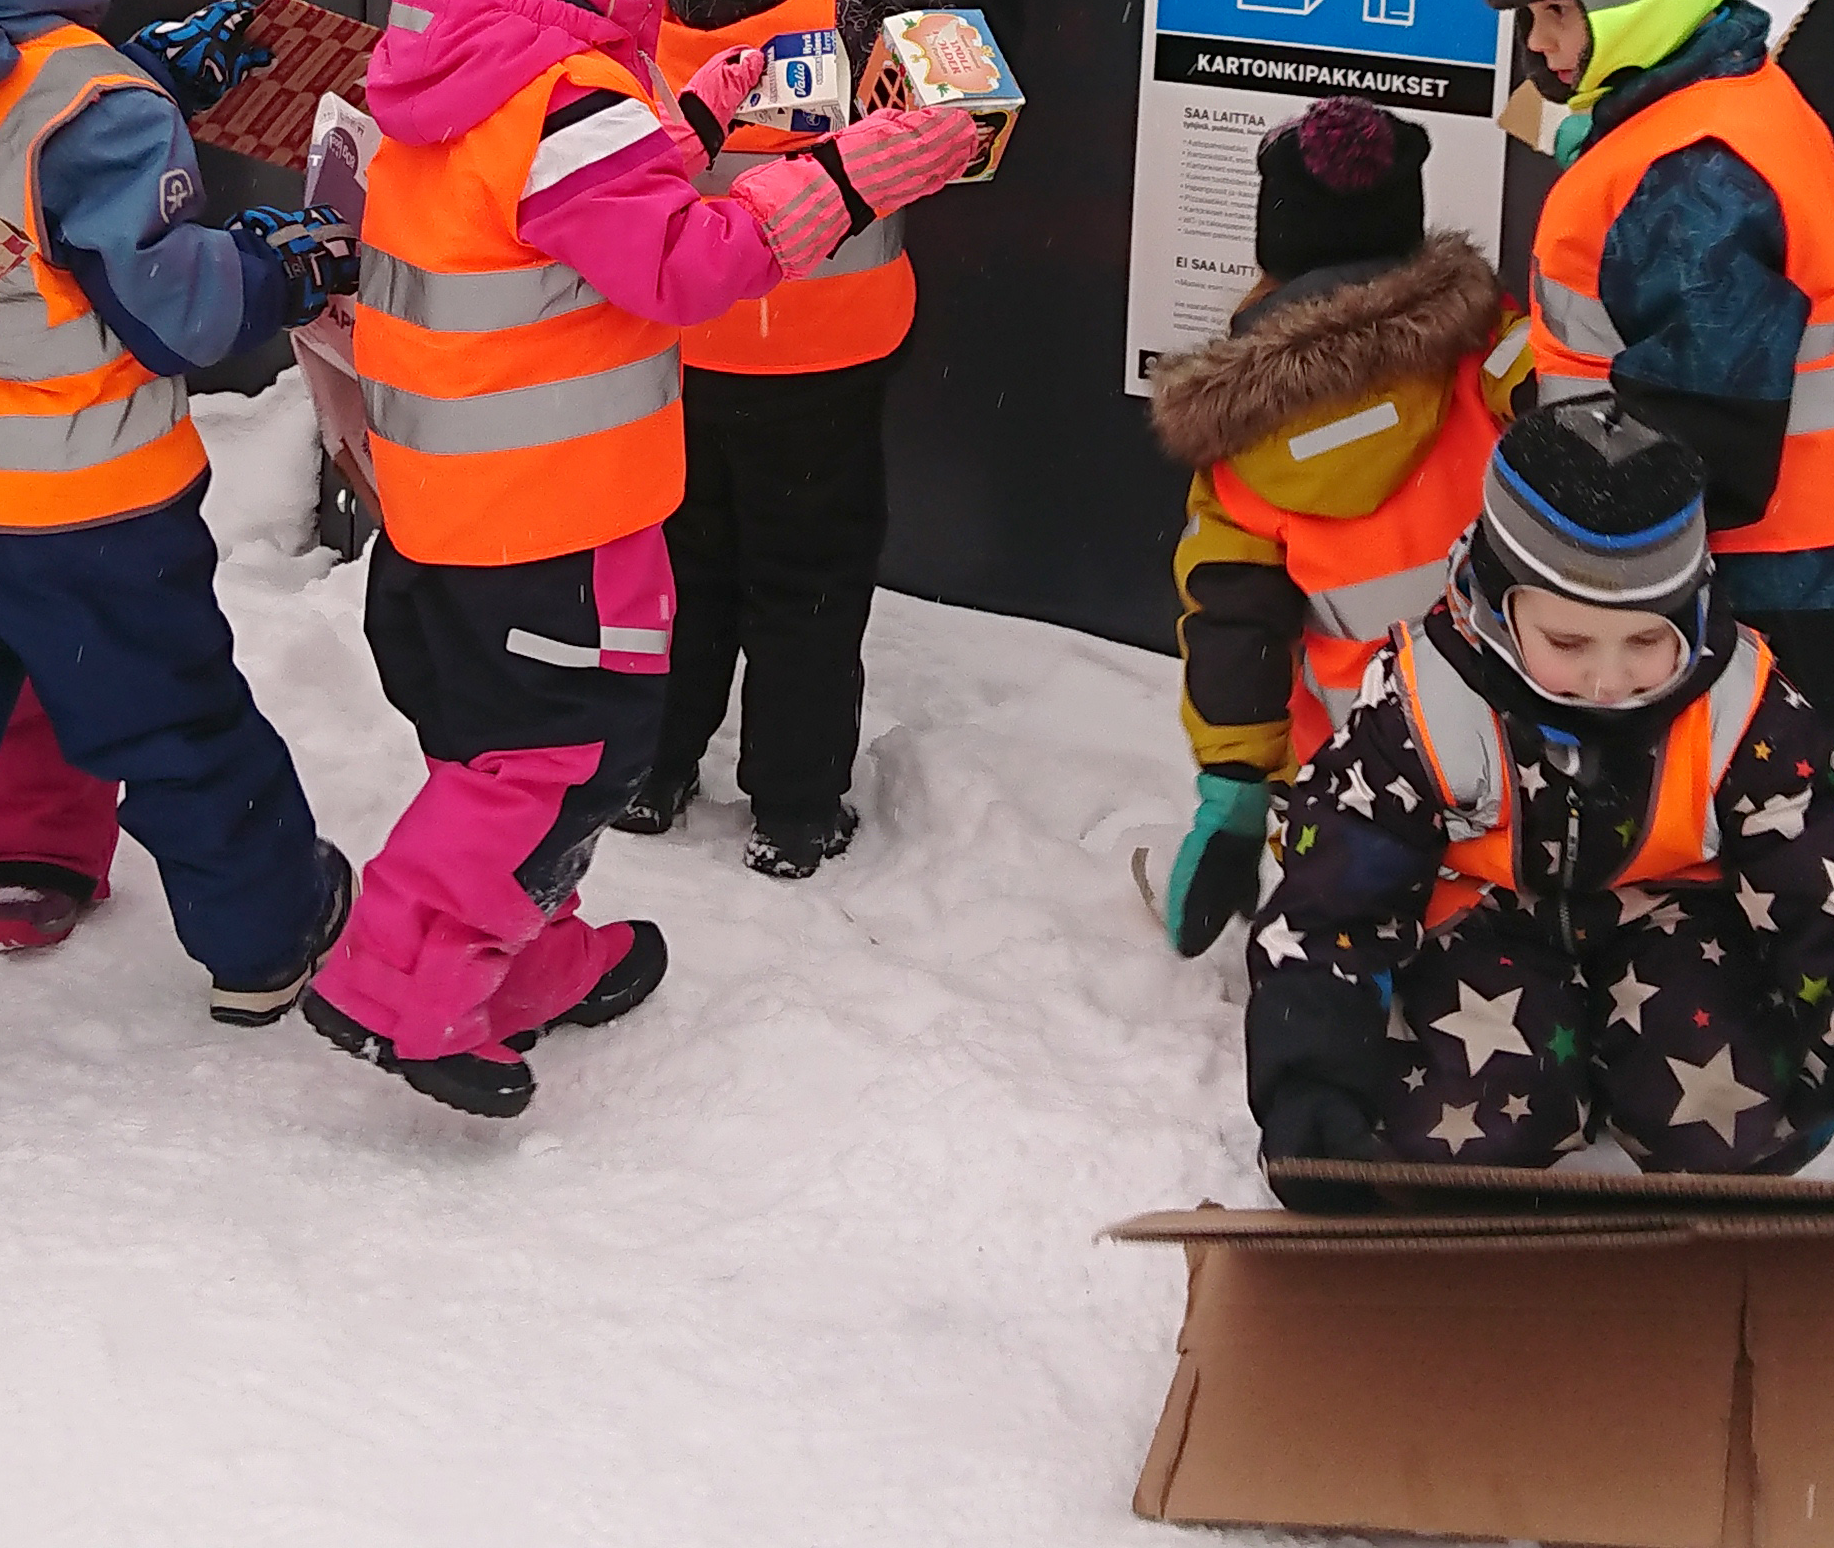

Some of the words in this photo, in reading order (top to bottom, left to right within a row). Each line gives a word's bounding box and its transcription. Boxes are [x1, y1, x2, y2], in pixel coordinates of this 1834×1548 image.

[793, 63, 806, 96] Valio
[1196, 53, 1450, 98] KARTONKIPAKKAUKSET
[1184, 107, 1209, 120] SAA
[1213, 110, 1266, 127] LAITTAA
[1176, 256, 1188, 268] EI
[1191, 258, 1217, 272] SAA
[1220, 262, 1256, 277] LAITT
